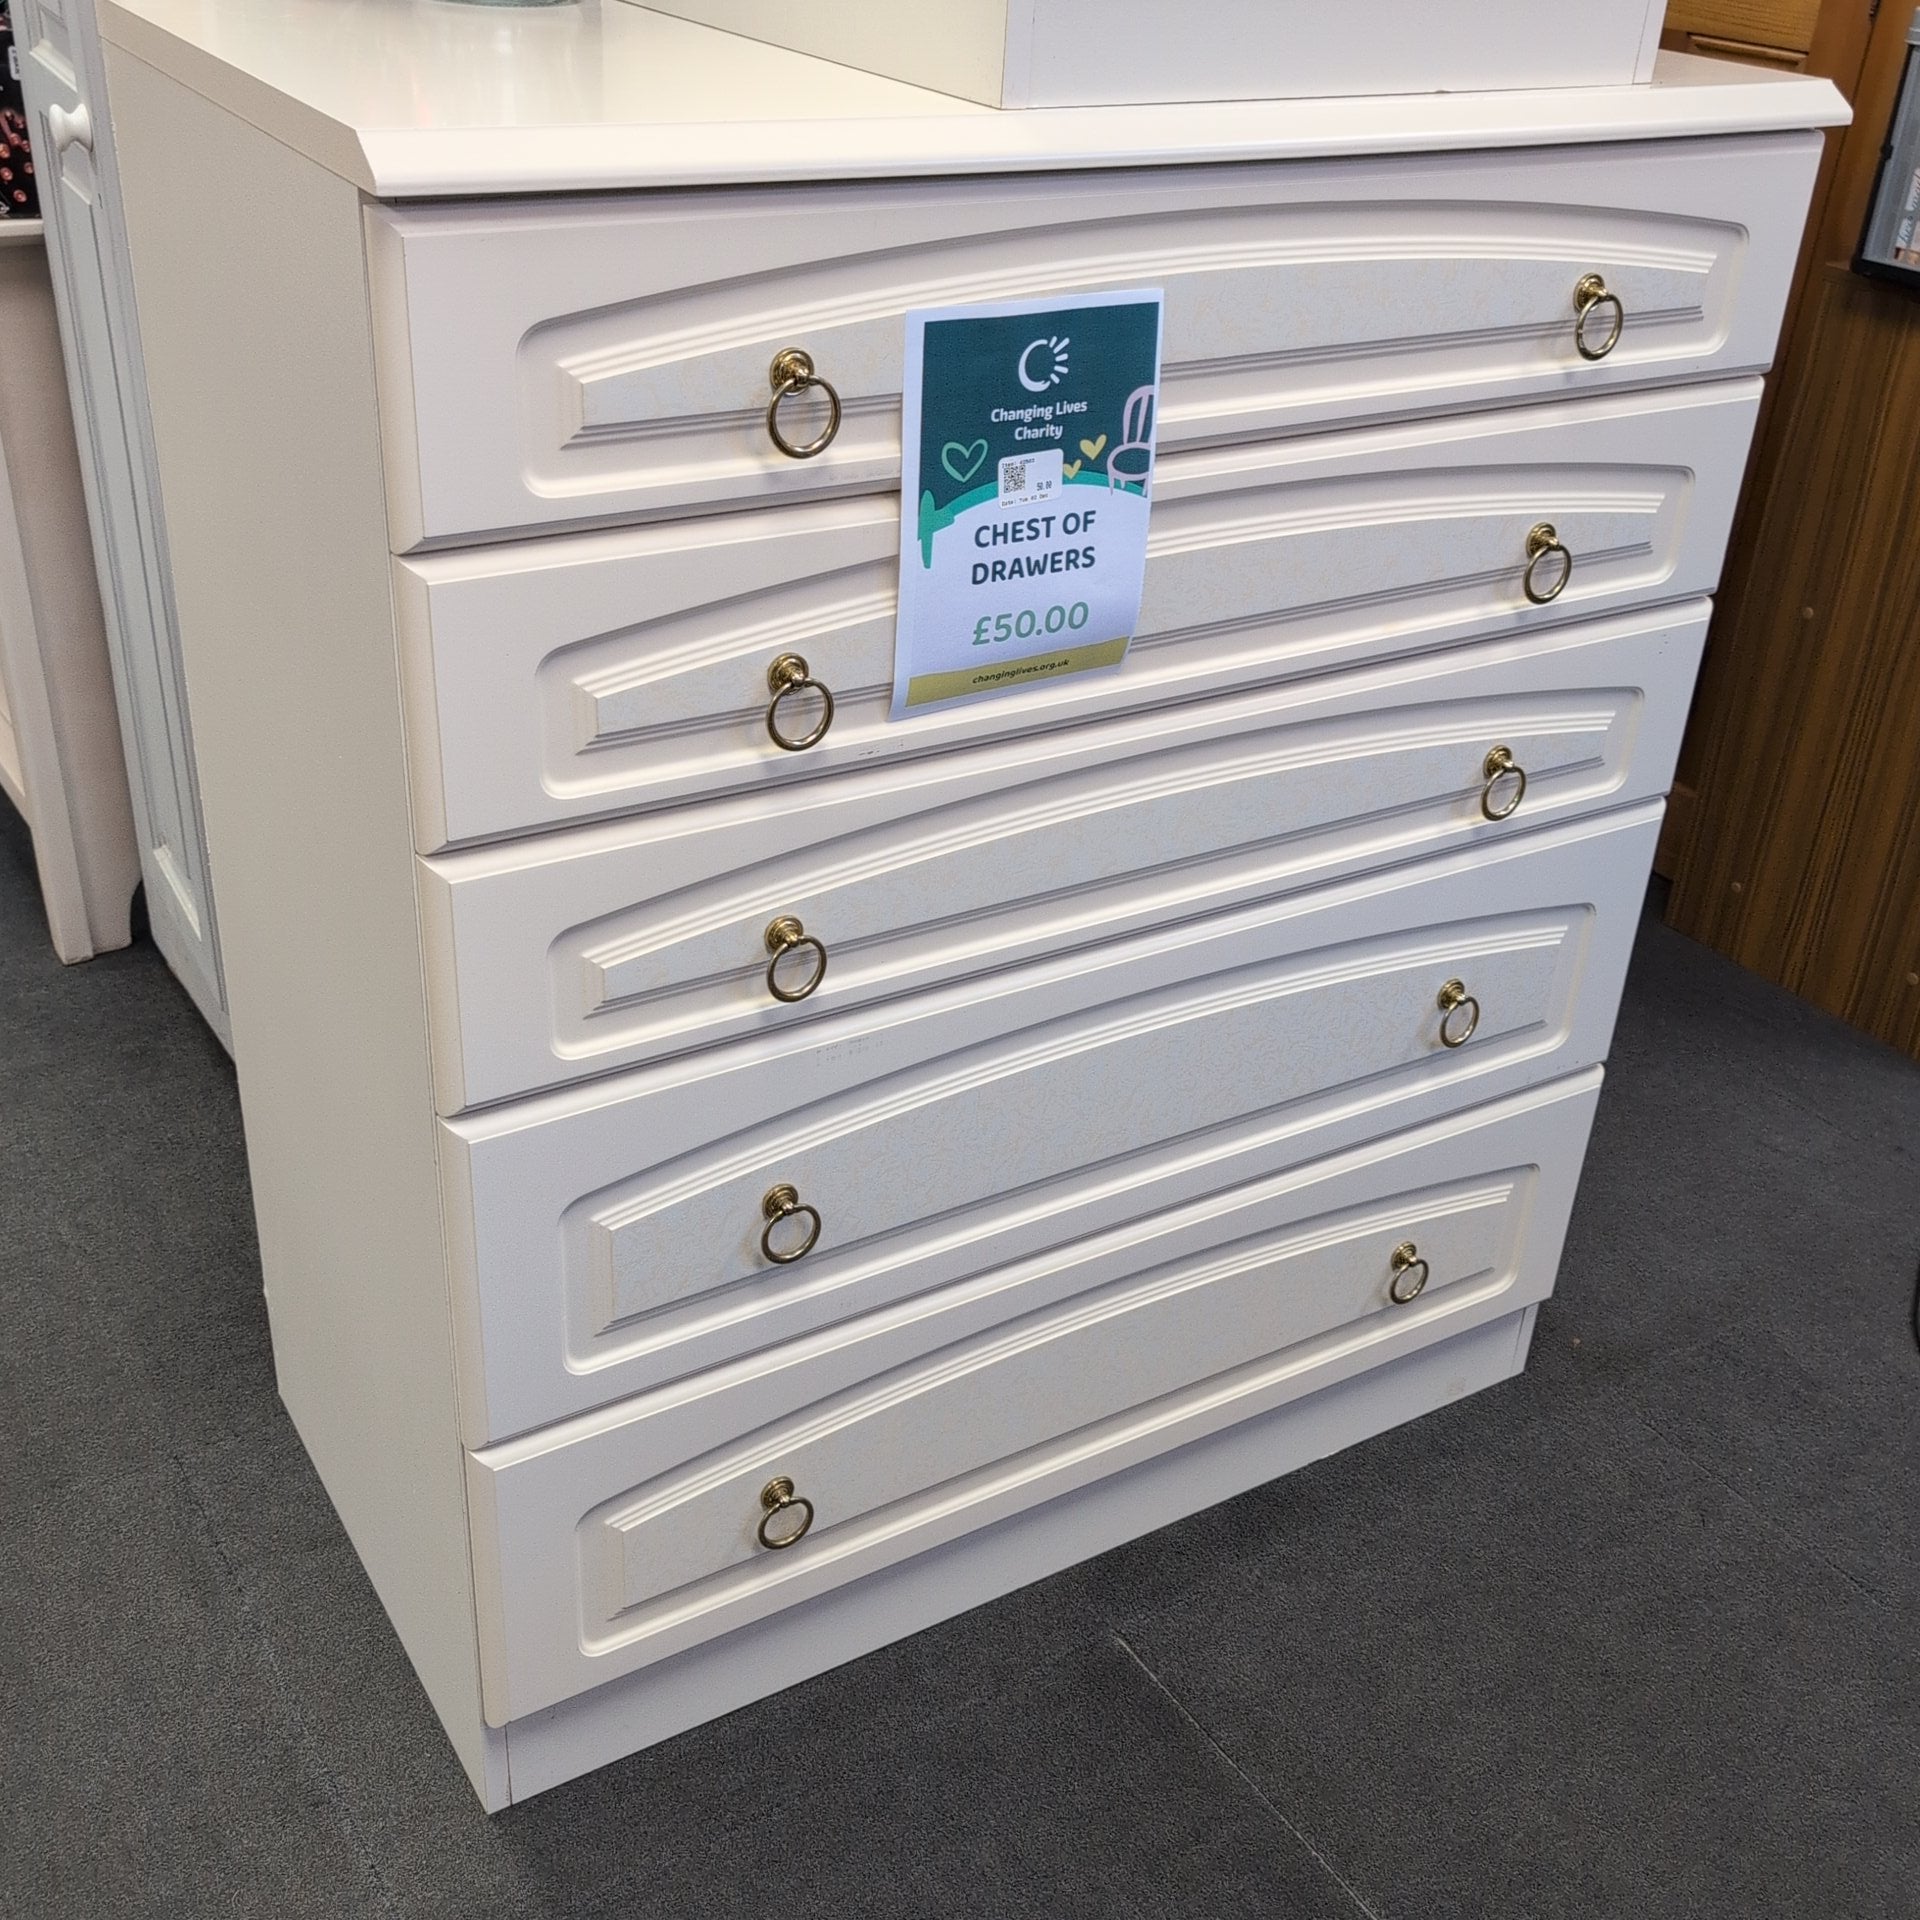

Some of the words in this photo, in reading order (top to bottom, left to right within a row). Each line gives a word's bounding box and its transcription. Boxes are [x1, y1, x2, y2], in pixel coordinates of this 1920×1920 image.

[990, 405, 1054, 423] Changing
[1055, 400, 1088, 416] Lives
[1014, 423, 1064, 441] Charity
[974, 515, 1056, 548] CHEST
[1062, 510, 1096, 535] OF
[971, 546, 1096, 585] DRAWERS
[972, 601, 1089, 645] £50.00
[972, 658, 1070, 684] changinglives.org.uk
